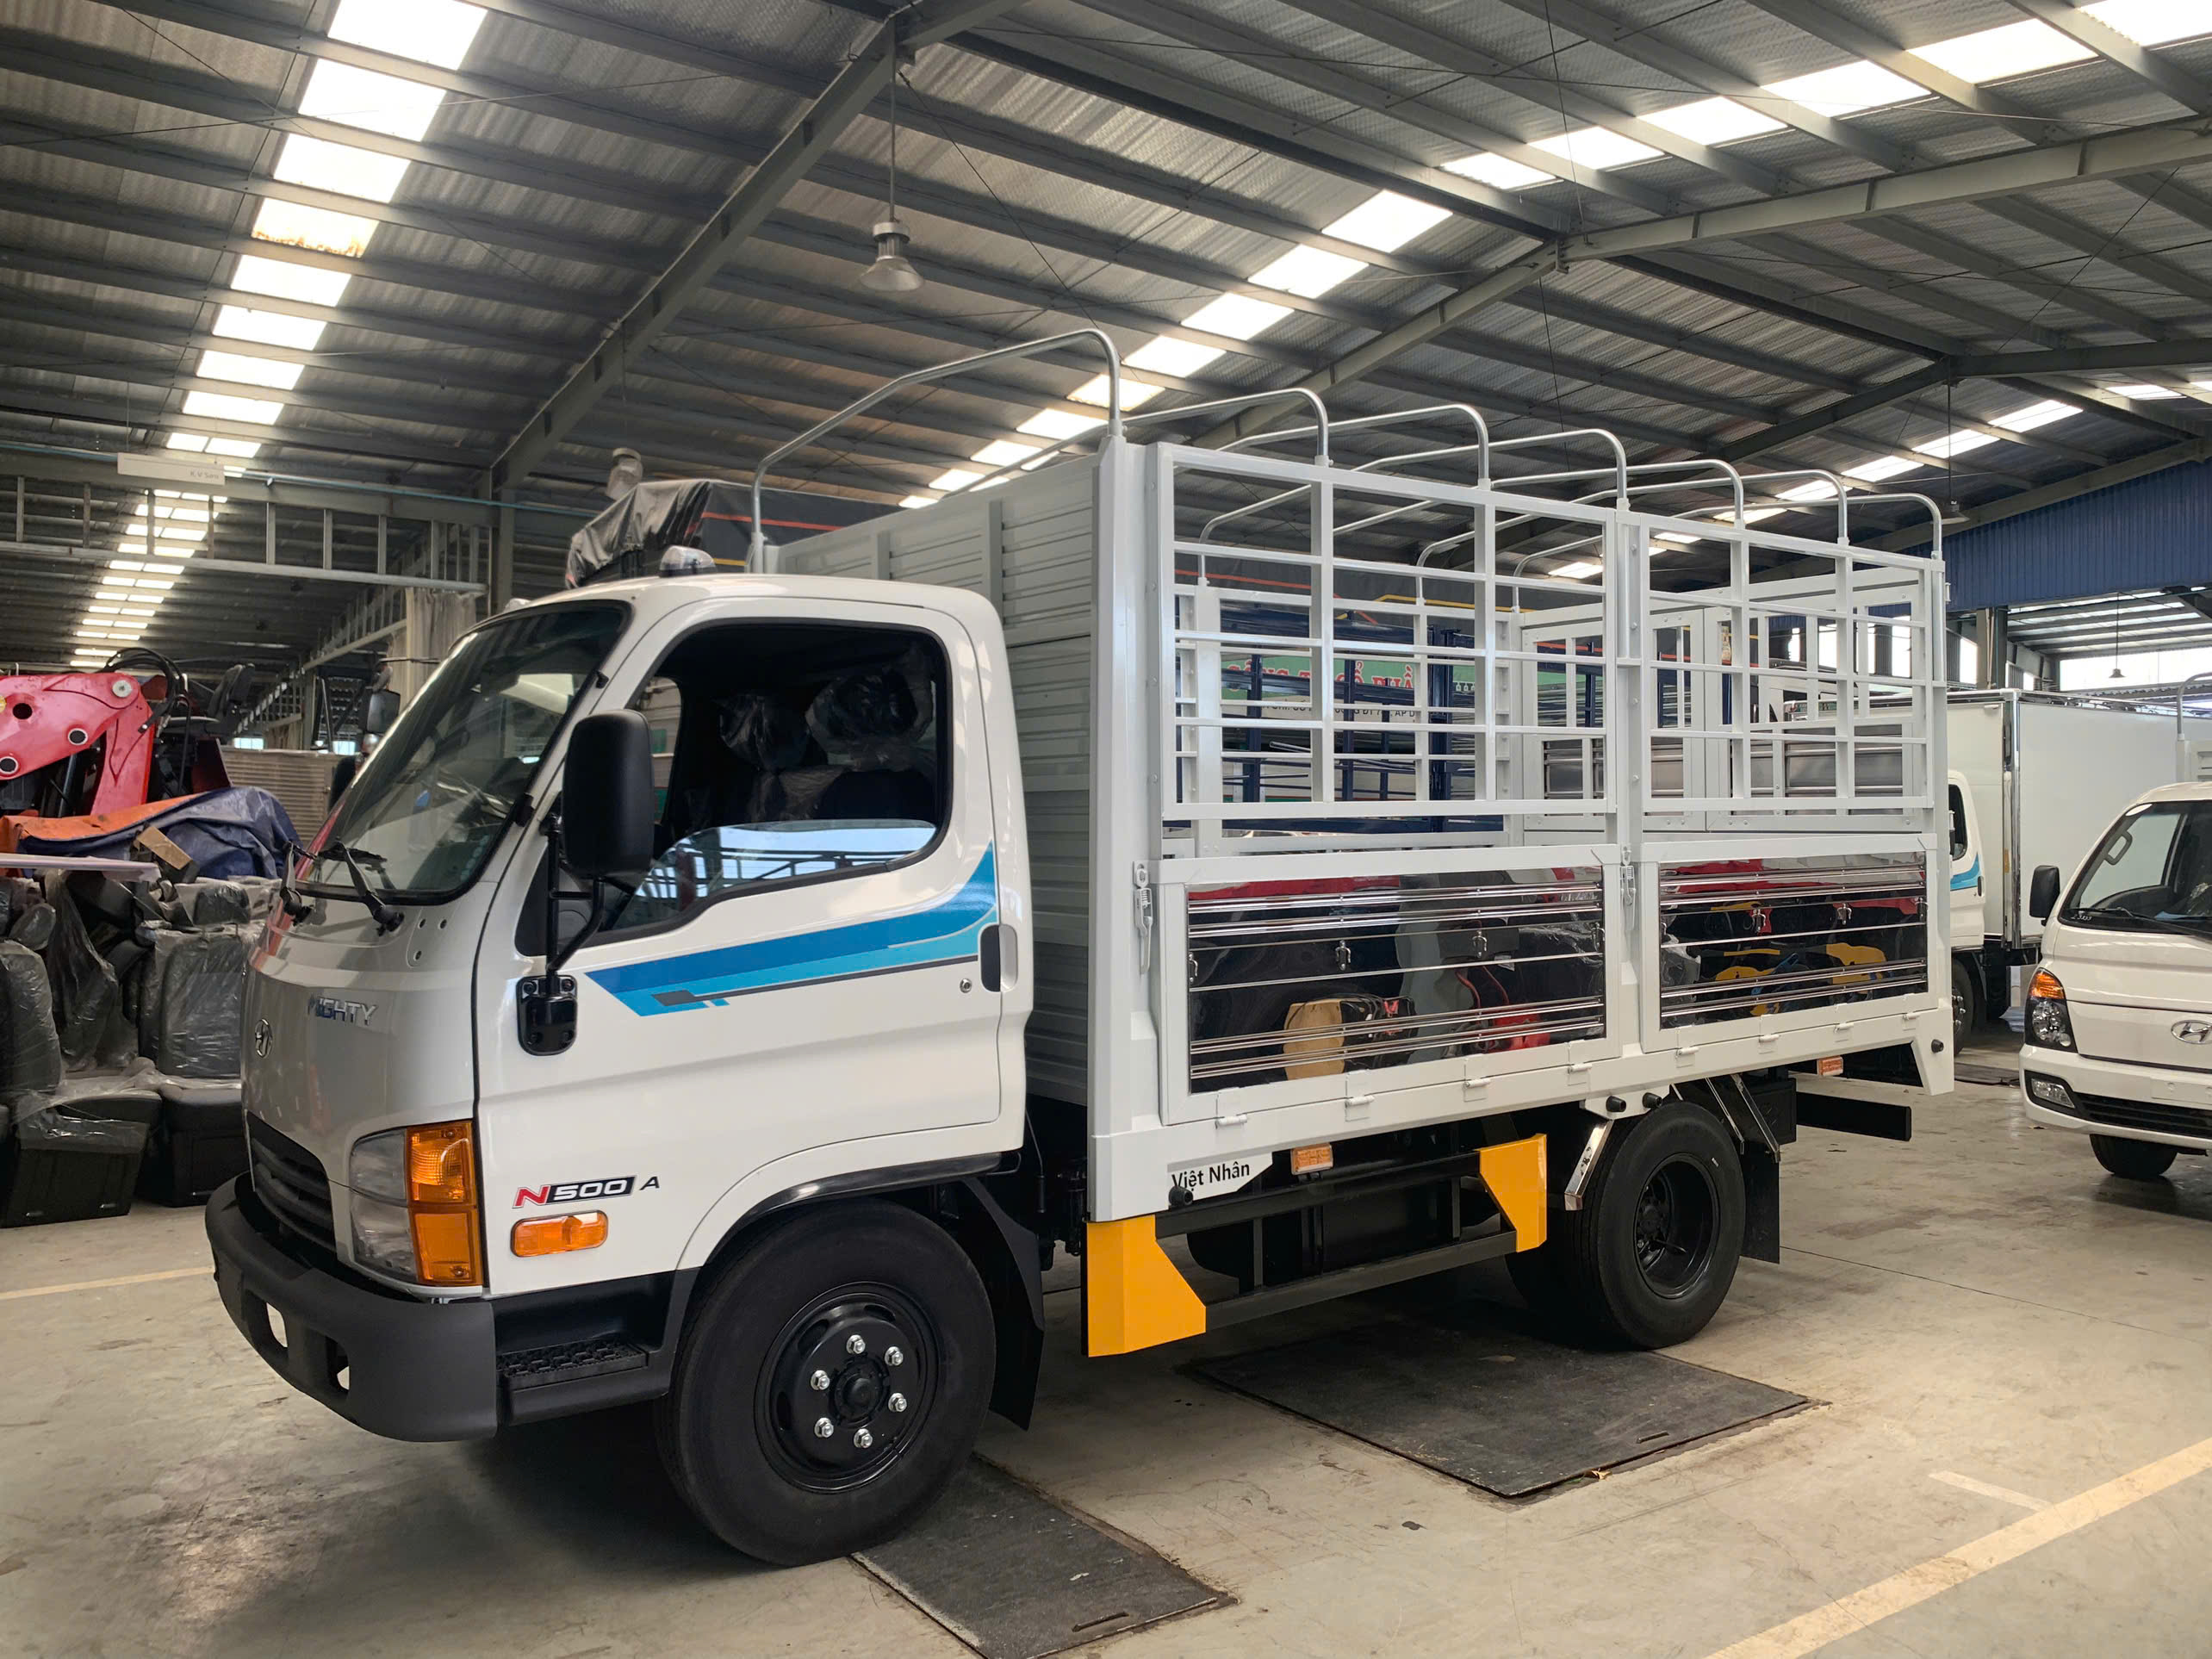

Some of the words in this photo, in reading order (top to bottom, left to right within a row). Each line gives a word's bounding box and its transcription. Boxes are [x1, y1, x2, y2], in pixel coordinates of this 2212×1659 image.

[308, 994, 376, 1026] MIGHTY
[513, 1177, 631, 1208] N500
[640, 1176, 660, 1191] A
[1171, 1171, 1204, 1192] Việt
[1209, 1161, 1250, 1184] Nhân
